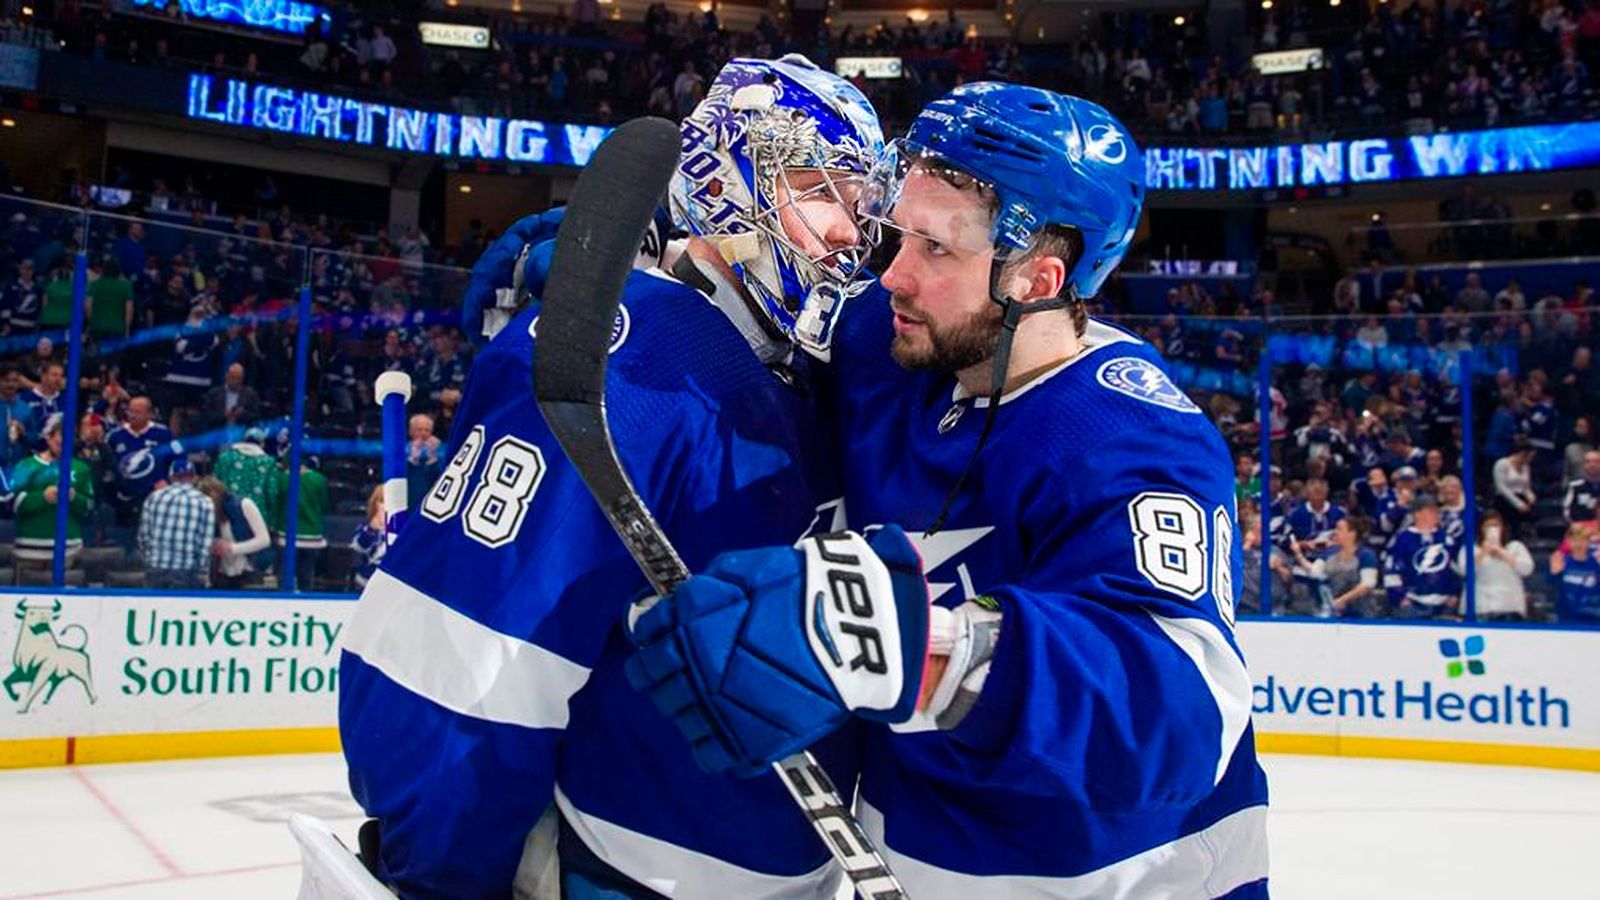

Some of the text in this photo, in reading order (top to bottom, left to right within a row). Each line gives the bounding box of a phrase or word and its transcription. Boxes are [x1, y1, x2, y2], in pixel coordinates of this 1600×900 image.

[420, 26, 472, 42] CHASE
[187, 73, 548, 161] LIGHTNING
[1144, 139, 1393, 188] HTNING
[420, 424, 547, 549] 88
[125, 609, 343, 655] University
[121, 656, 339, 696] South Flor
